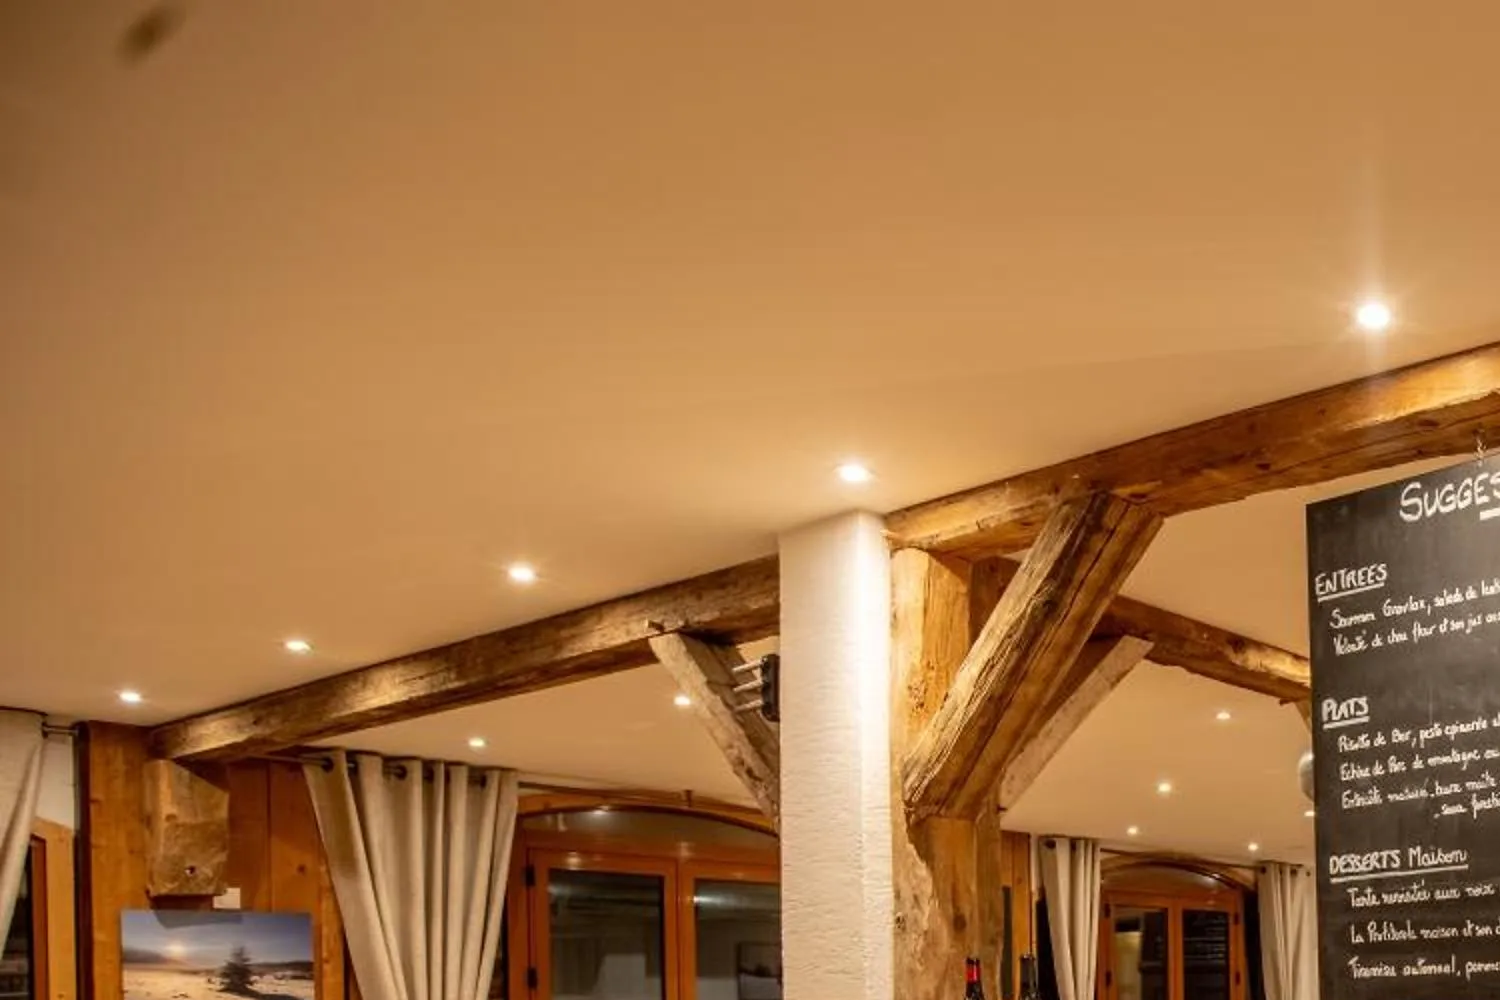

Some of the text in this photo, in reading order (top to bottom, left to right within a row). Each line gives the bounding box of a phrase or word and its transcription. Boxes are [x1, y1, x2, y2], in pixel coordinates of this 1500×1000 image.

[1314, 563, 1388, 596] ENTREES
[1321, 696, 1369, 721] PLATS
[1329, 849, 1402, 875] DESSERTS
